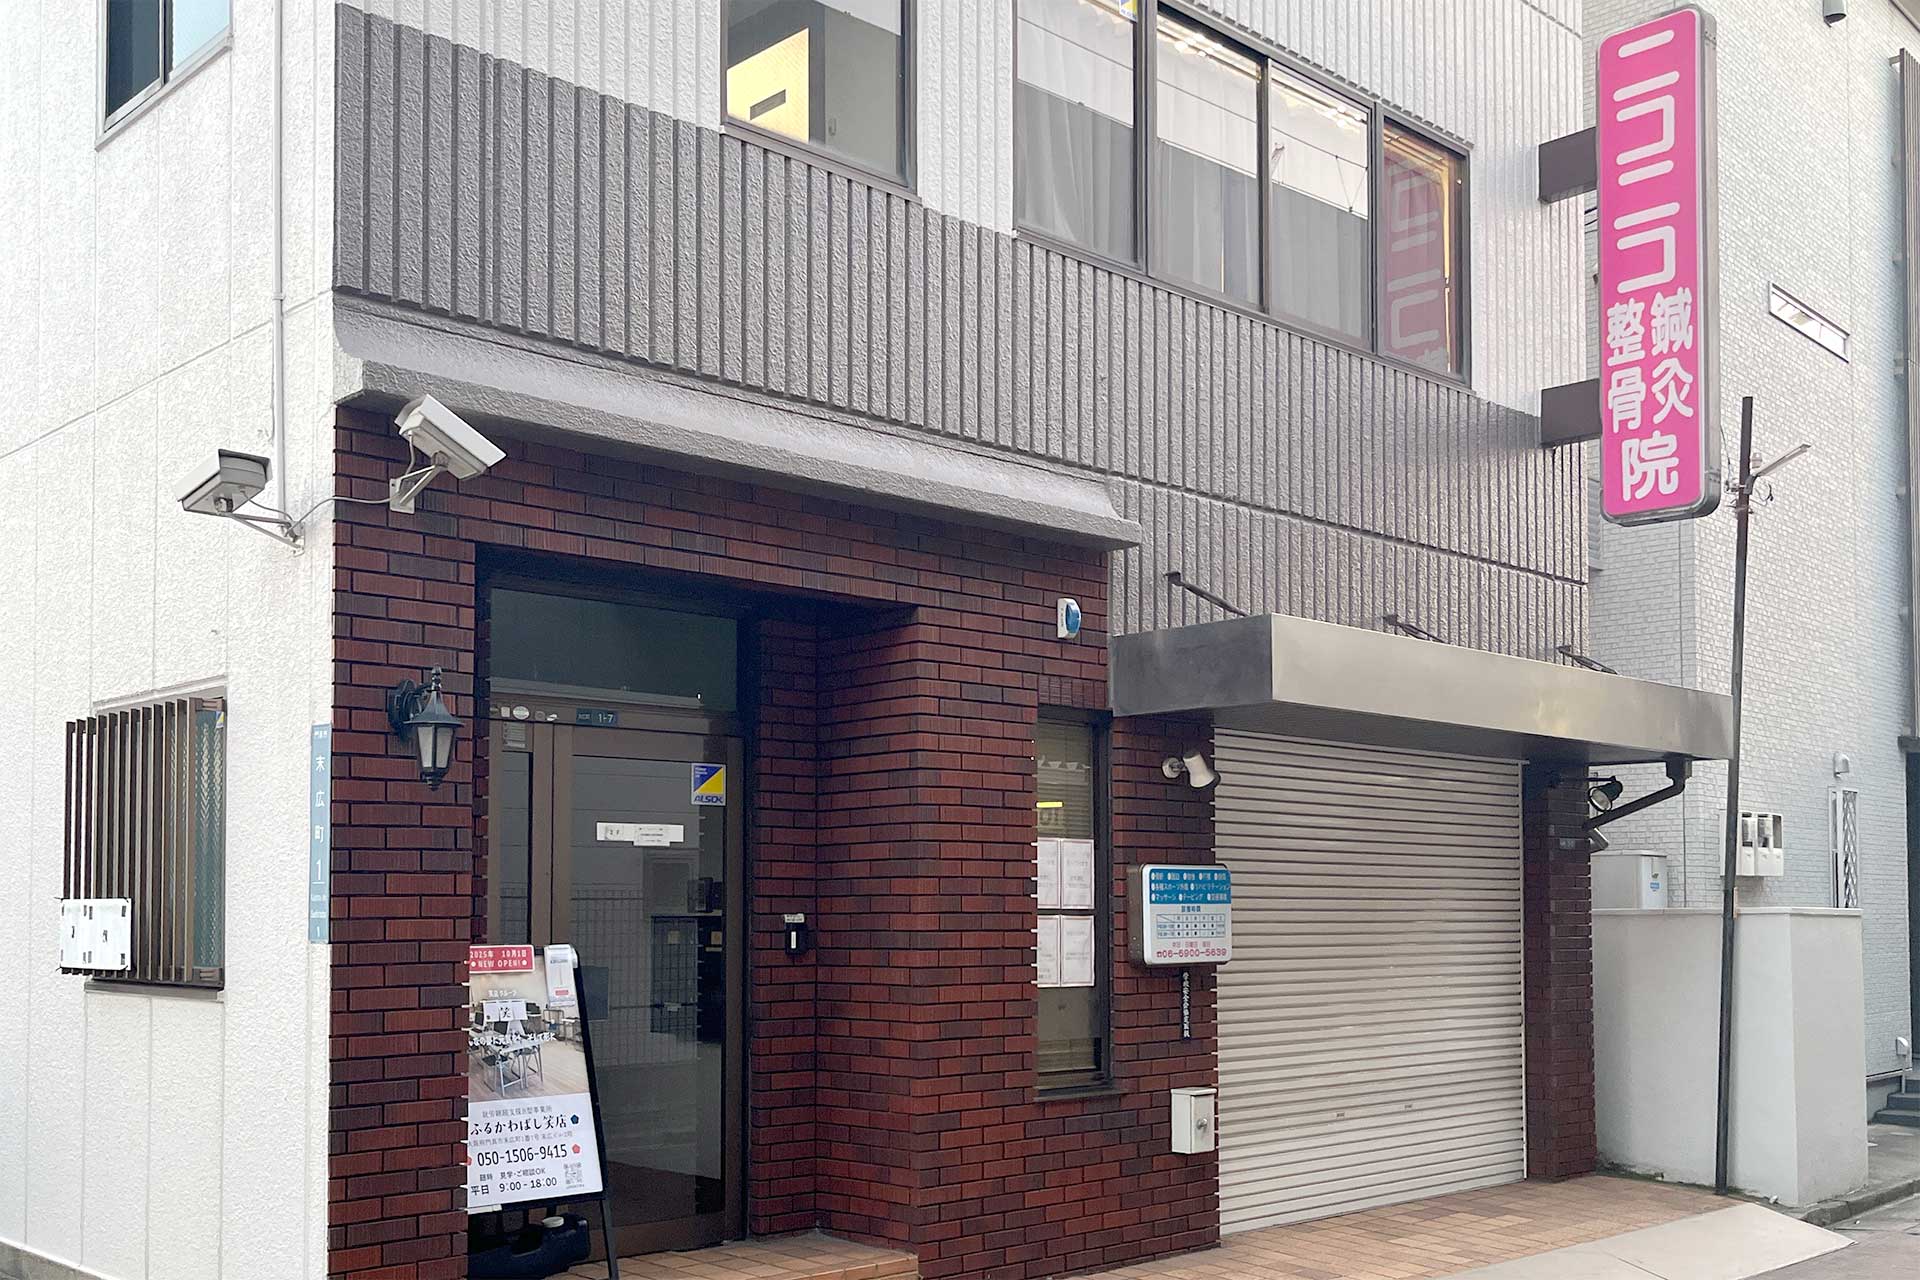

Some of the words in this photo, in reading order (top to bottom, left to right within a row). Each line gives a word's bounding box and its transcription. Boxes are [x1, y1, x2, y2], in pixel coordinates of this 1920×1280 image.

[1612, 28, 1681, 295] ニコニコ
[693, 795, 724, 805] ALSOK
[477, 960, 495, 968] NEW
[470, 1114, 567, 1135] ふるかわばし笑店
[477, 1144, 567, 1166] 050-1506-9415
[470, 1184, 490, 1196] 平日
